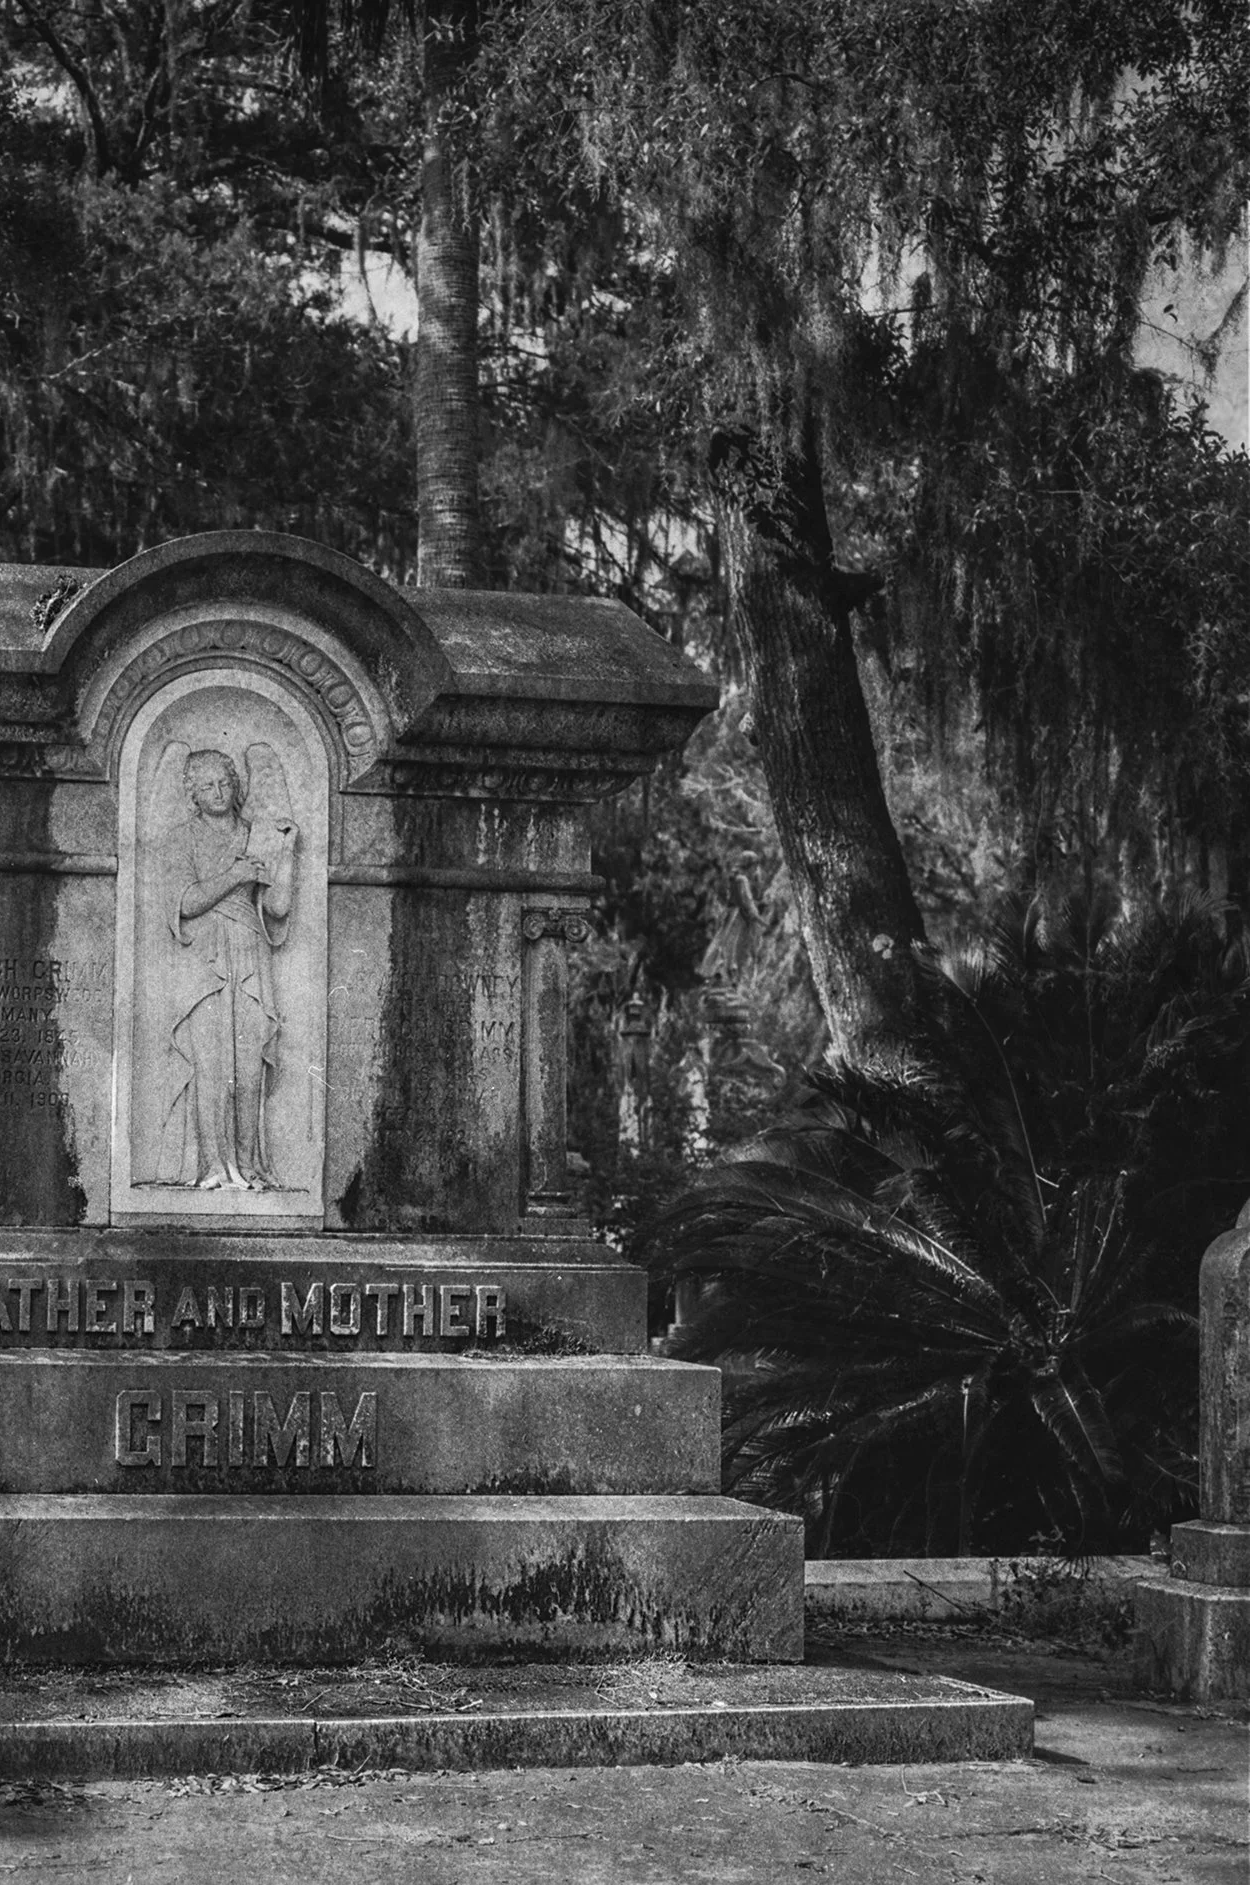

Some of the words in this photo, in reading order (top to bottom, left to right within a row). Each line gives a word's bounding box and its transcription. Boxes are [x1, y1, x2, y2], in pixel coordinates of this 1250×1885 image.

[170, 1285, 267, 1331] AND
[279, 1281, 508, 1339] MOTHER
[114, 1389, 379, 1469] GRIMM
